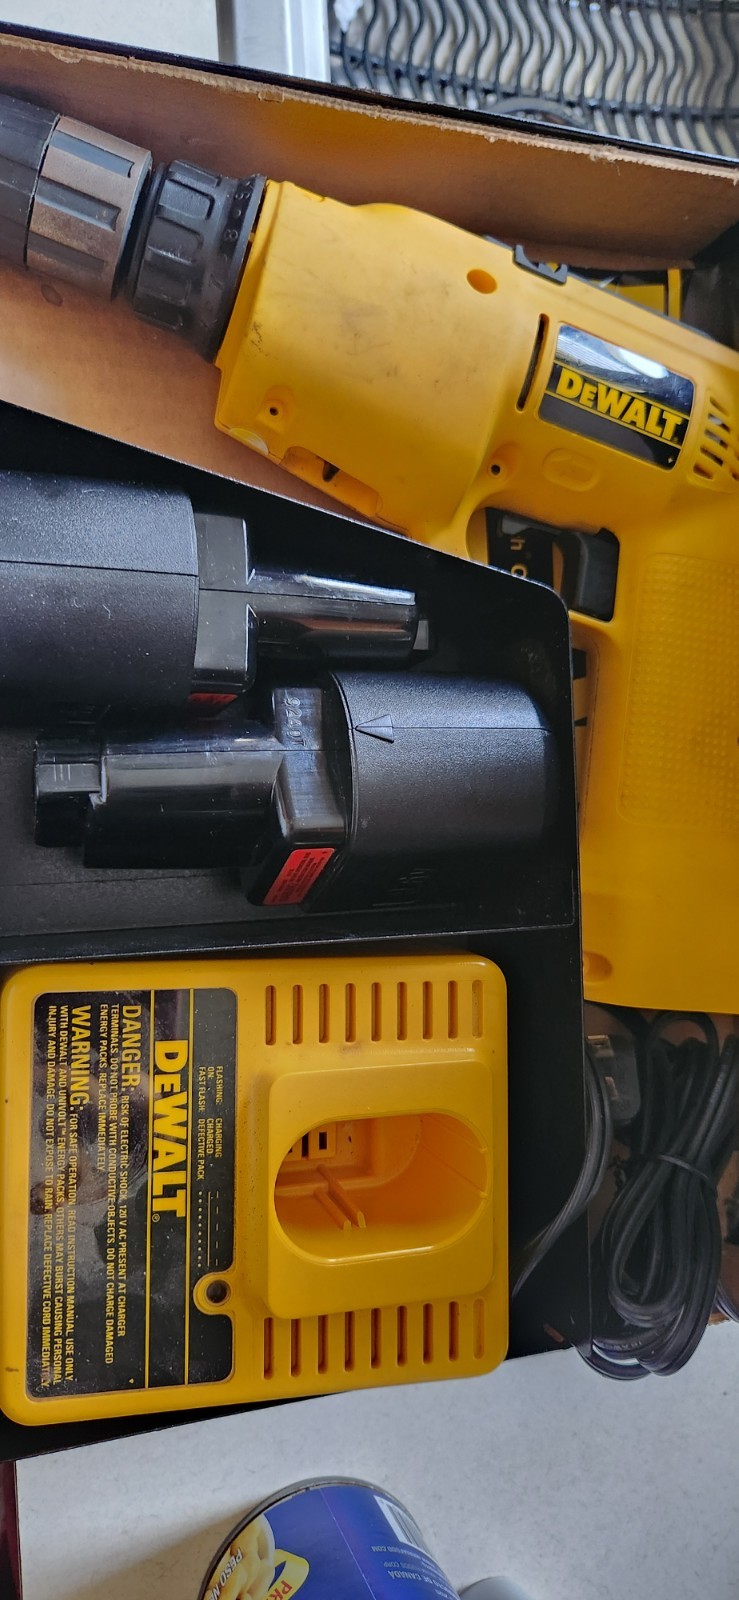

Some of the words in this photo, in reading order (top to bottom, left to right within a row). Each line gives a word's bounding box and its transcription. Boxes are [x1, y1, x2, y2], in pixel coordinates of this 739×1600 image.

[48, 1006, 56, 1037] INJURY
[60, 1005, 68, 1028] WITH
[100, 1004, 108, 1037] ENERGY
[110, 1004, 119, 1056] TERMINALS.
[48, 1040, 56, 1058] AND
[59, 1031, 68, 1066] DEWALT
[70, 1005, 91, 1111] WARNING:
[120, 1005, 141, 1092] DANGER:
[59, 1069, 67, 1087] AND
[110, 1059, 118, 1070] DO
[47, 1062, 55, 1101] DAMAGE.
[98, 1073, 106, 1110] REPLACE
[110, 1072, 118, 1089] NOT
[46, 1104, 54, 1115] DO
[109, 1092, 117, 1120] PROBE
[121, 1096, 129, 1115] RISK
[198, 1087, 206, 1112] FLASH:
[46, 1118, 54, 1136] NOT
[70, 1113, 78, 1130] FOR
[109, 1122, 117, 1145] WITH
[121, 1117, 128, 1128] OF
[45, 1140, 54, 1172] EXPOSE
[57, 1138, 65, 1171] ENERGY
[69, 1133, 77, 1153] SAFE
[97, 1113, 106, 1172] IMMEDIATELY.
[120, 1130, 128, 1168] ELECTRIC
[45, 1175, 53, 1185] TO
[108, 1148, 117, 1203] CONDUCTIVE
[55, 1207, 64, 1240] OTHERS
[68, 1210, 76, 1232] READ
[119, 1205, 127, 1218] 120
[43, 1215, 52, 1251] REPLACE
[107, 1205, 115, 1246] OBJECTS.
[118, 1228, 126, 1240] AC
[55, 1243, 63, 1263] MAY
[66, 1235, 76, 1293] INSTRUCTION
[107, 1249, 114, 1259] DO
[118, 1242, 126, 1279] PRESENT
[43, 1254, 51, 1299] DEFECTIVE
[54, 1266, 63, 1293] BURST
[106, 1263, 114, 1280] NOT
[105, 1283, 114, 1317] CHARGE
[118, 1283, 126, 1293] AT
[42, 1301, 50, 1324] CORD
[54, 1297, 63, 1336] CAUSING
[117, 1296, 125, 1336] CHARGER
[65, 1338, 74, 1355] USE
[105, 1320, 113, 1363] DAMAGED
[53, 1338, 62, 1385] PERSONAL
[65, 1358, 73, 1381] ONLY
[219, 1548, 243, 1587] PESO
[267, 1580, 293, 1600] PR
